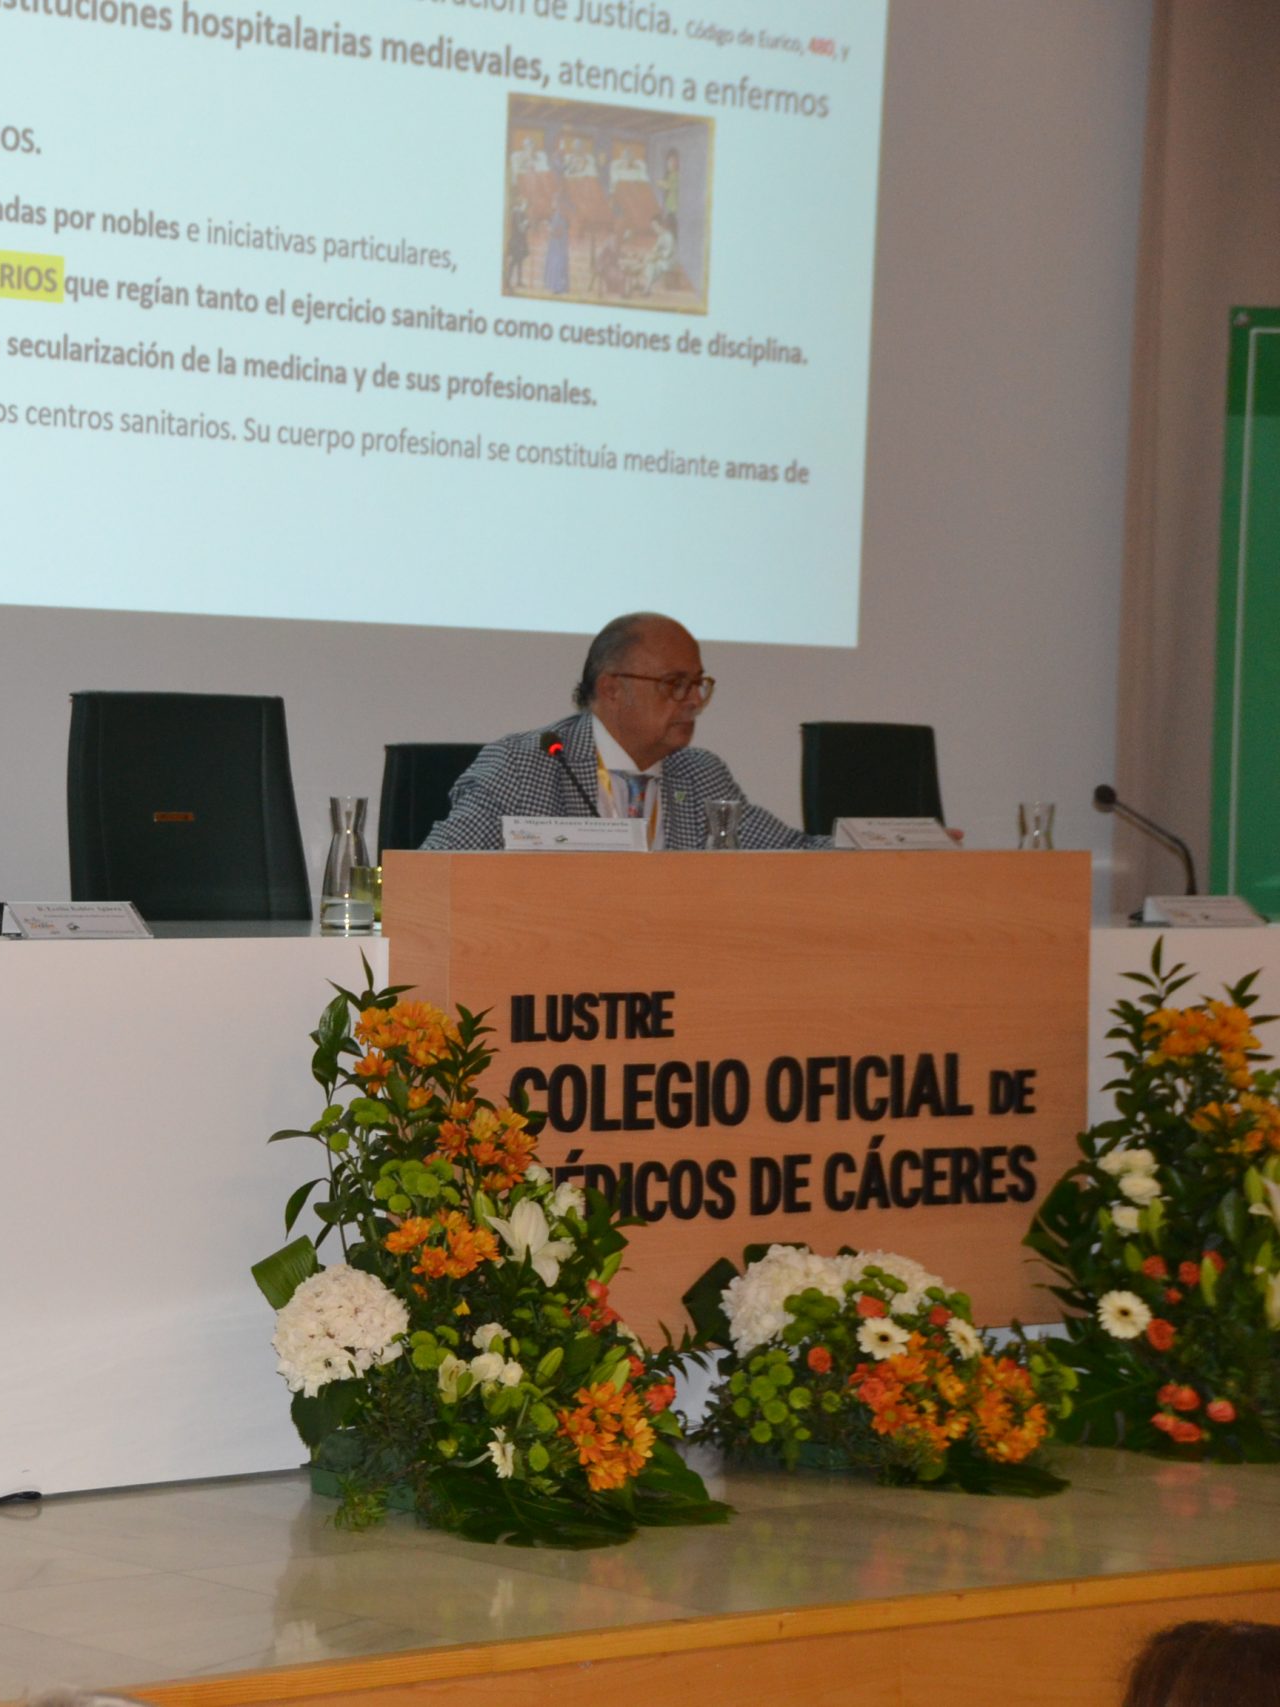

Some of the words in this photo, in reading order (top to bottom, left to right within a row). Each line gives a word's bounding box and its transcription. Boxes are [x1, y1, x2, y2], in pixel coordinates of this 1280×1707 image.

[573, 0, 678, 36] Justicia.
[181, 0, 373, 59] hospitalarias
[380, 35, 550, 89] medievales,
[558, 60, 675, 99] atención
[681, 77, 697, 102] a
[704, 77, 829, 118] enfermos
[53, 207, 96, 236] por
[101, 208, 181, 241] nobles
[185, 221, 201, 243] e
[207, 218, 317, 255] iniciativas
[323, 235, 458, 274] particulares,
[63, 274, 110, 303] que
[116, 276, 190, 310] regían
[195, 283, 259, 314] tanto
[264, 288, 286, 316] el
[291, 292, 386, 326] ejercicio
[391, 302, 488, 335] sanitario
[493, 317, 554, 341] como
[559, 321, 672, 354] cuestiones
[677, 329, 702, 355] de
[707, 332, 808, 367] disciplina.
[6, 332, 175, 371] secularización
[180, 344, 211, 374] de
[216, 346, 237, 376] la
[243, 353, 348, 385] medicina
[353, 367, 367, 393] y
[372, 361, 401, 389] de
[406, 372, 442, 393] sus
[447, 372, 598, 407] profesionales.
[24, 403, 115, 432] centros
[119, 409, 238, 441] sanitarios.
[243, 416, 271, 444] Su
[276, 426, 355, 456] cuerpo
[361, 427, 482, 461] profesional
[486, 442, 511, 462] se
[515, 443, 618, 470] constituía
[623, 449, 720, 478] mediante
[724, 458, 779, 482] amas
[784, 458, 810, 484] de
[510, 991, 676, 1043] ILUSTRE
[509, 1058, 750, 1136] COLEGIO
[765, 1052, 974, 1123] OFICIAL
[989, 1069, 1037, 1115] DE
[545, 1148, 737, 1222] ÉDICOS
[749, 1153, 812, 1216] DE
[824, 1134, 1038, 1214] CÁCERES
